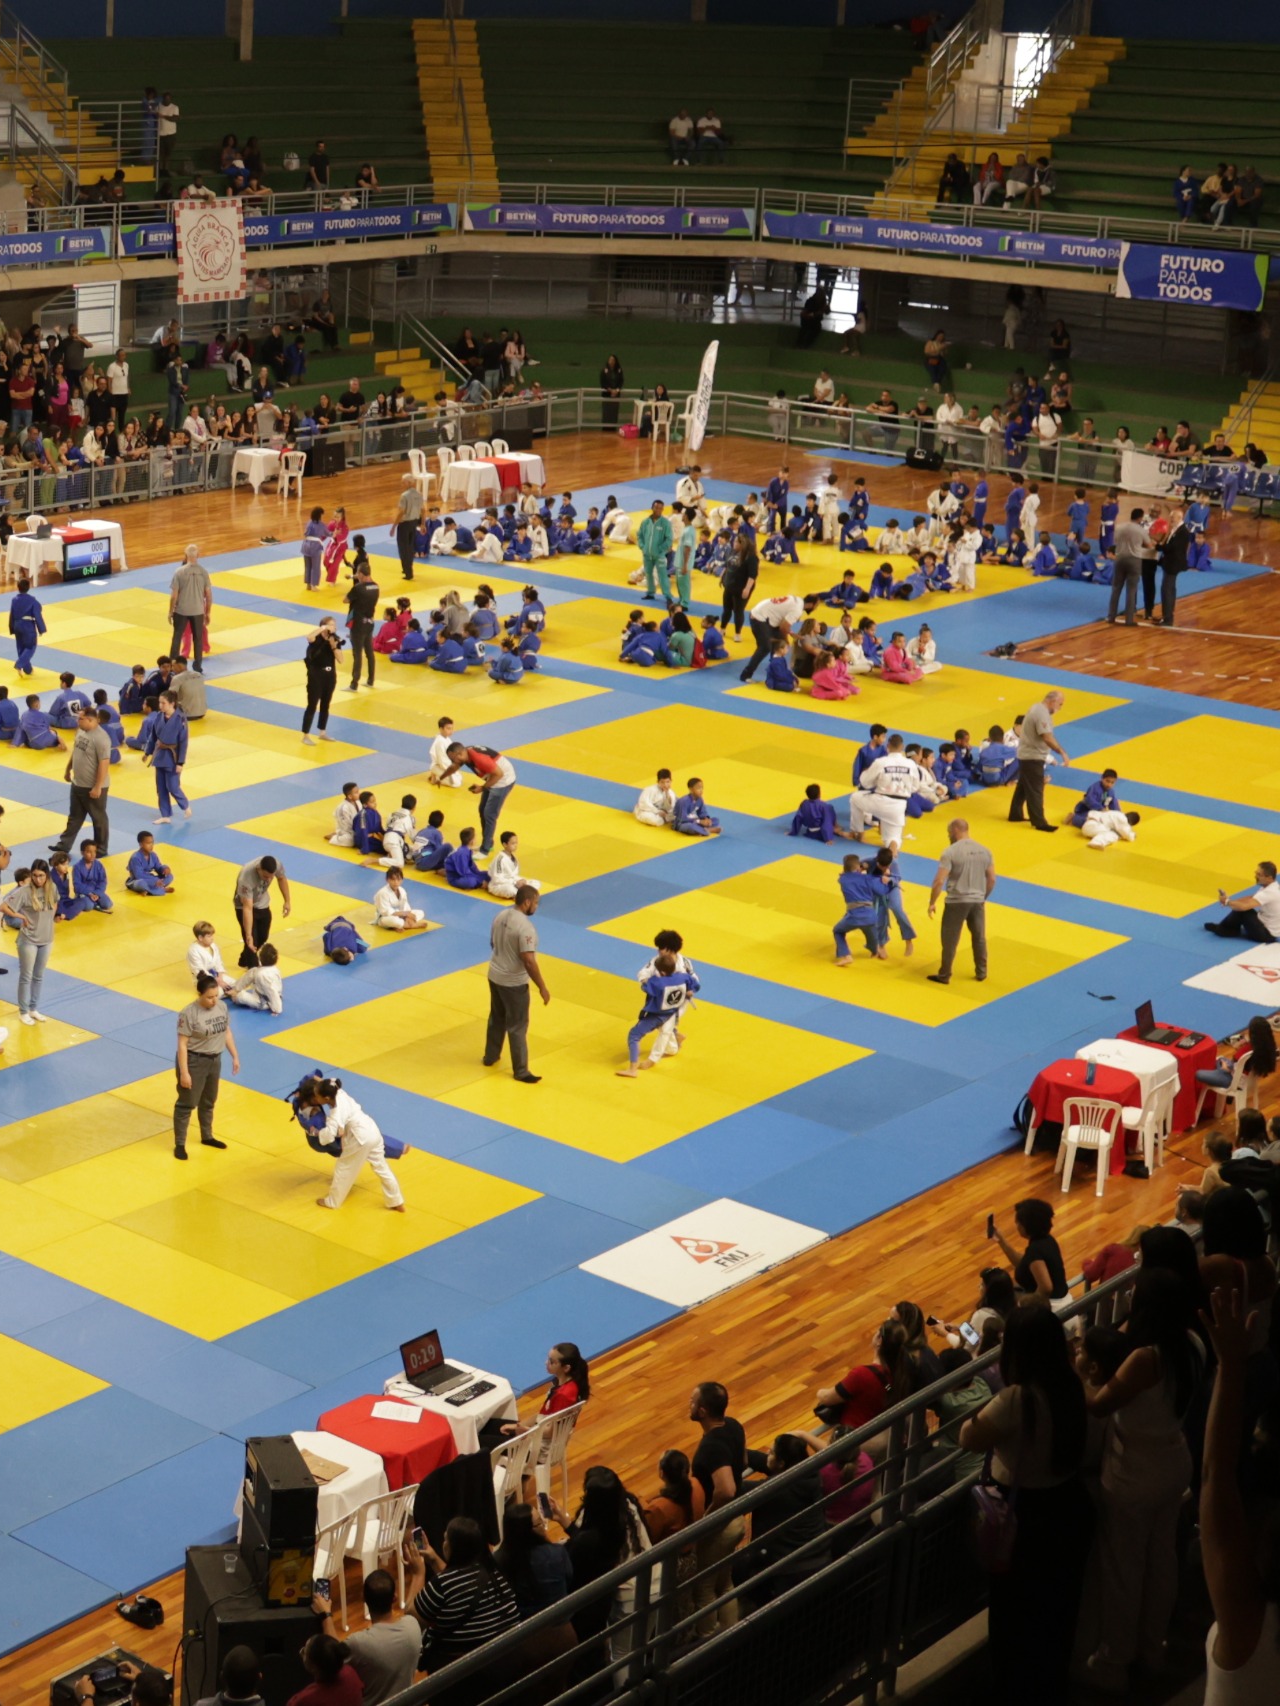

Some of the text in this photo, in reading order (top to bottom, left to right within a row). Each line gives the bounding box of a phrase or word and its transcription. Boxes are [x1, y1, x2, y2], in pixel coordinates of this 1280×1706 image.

[1160, 254, 1225, 274] FUTURO
[1158, 269, 1198, 286] PARA
[1157, 282, 1212, 302] TODOS
[714, 1250, 750, 1268] FMJ
[410, 1344, 436, 1369] 0:19
